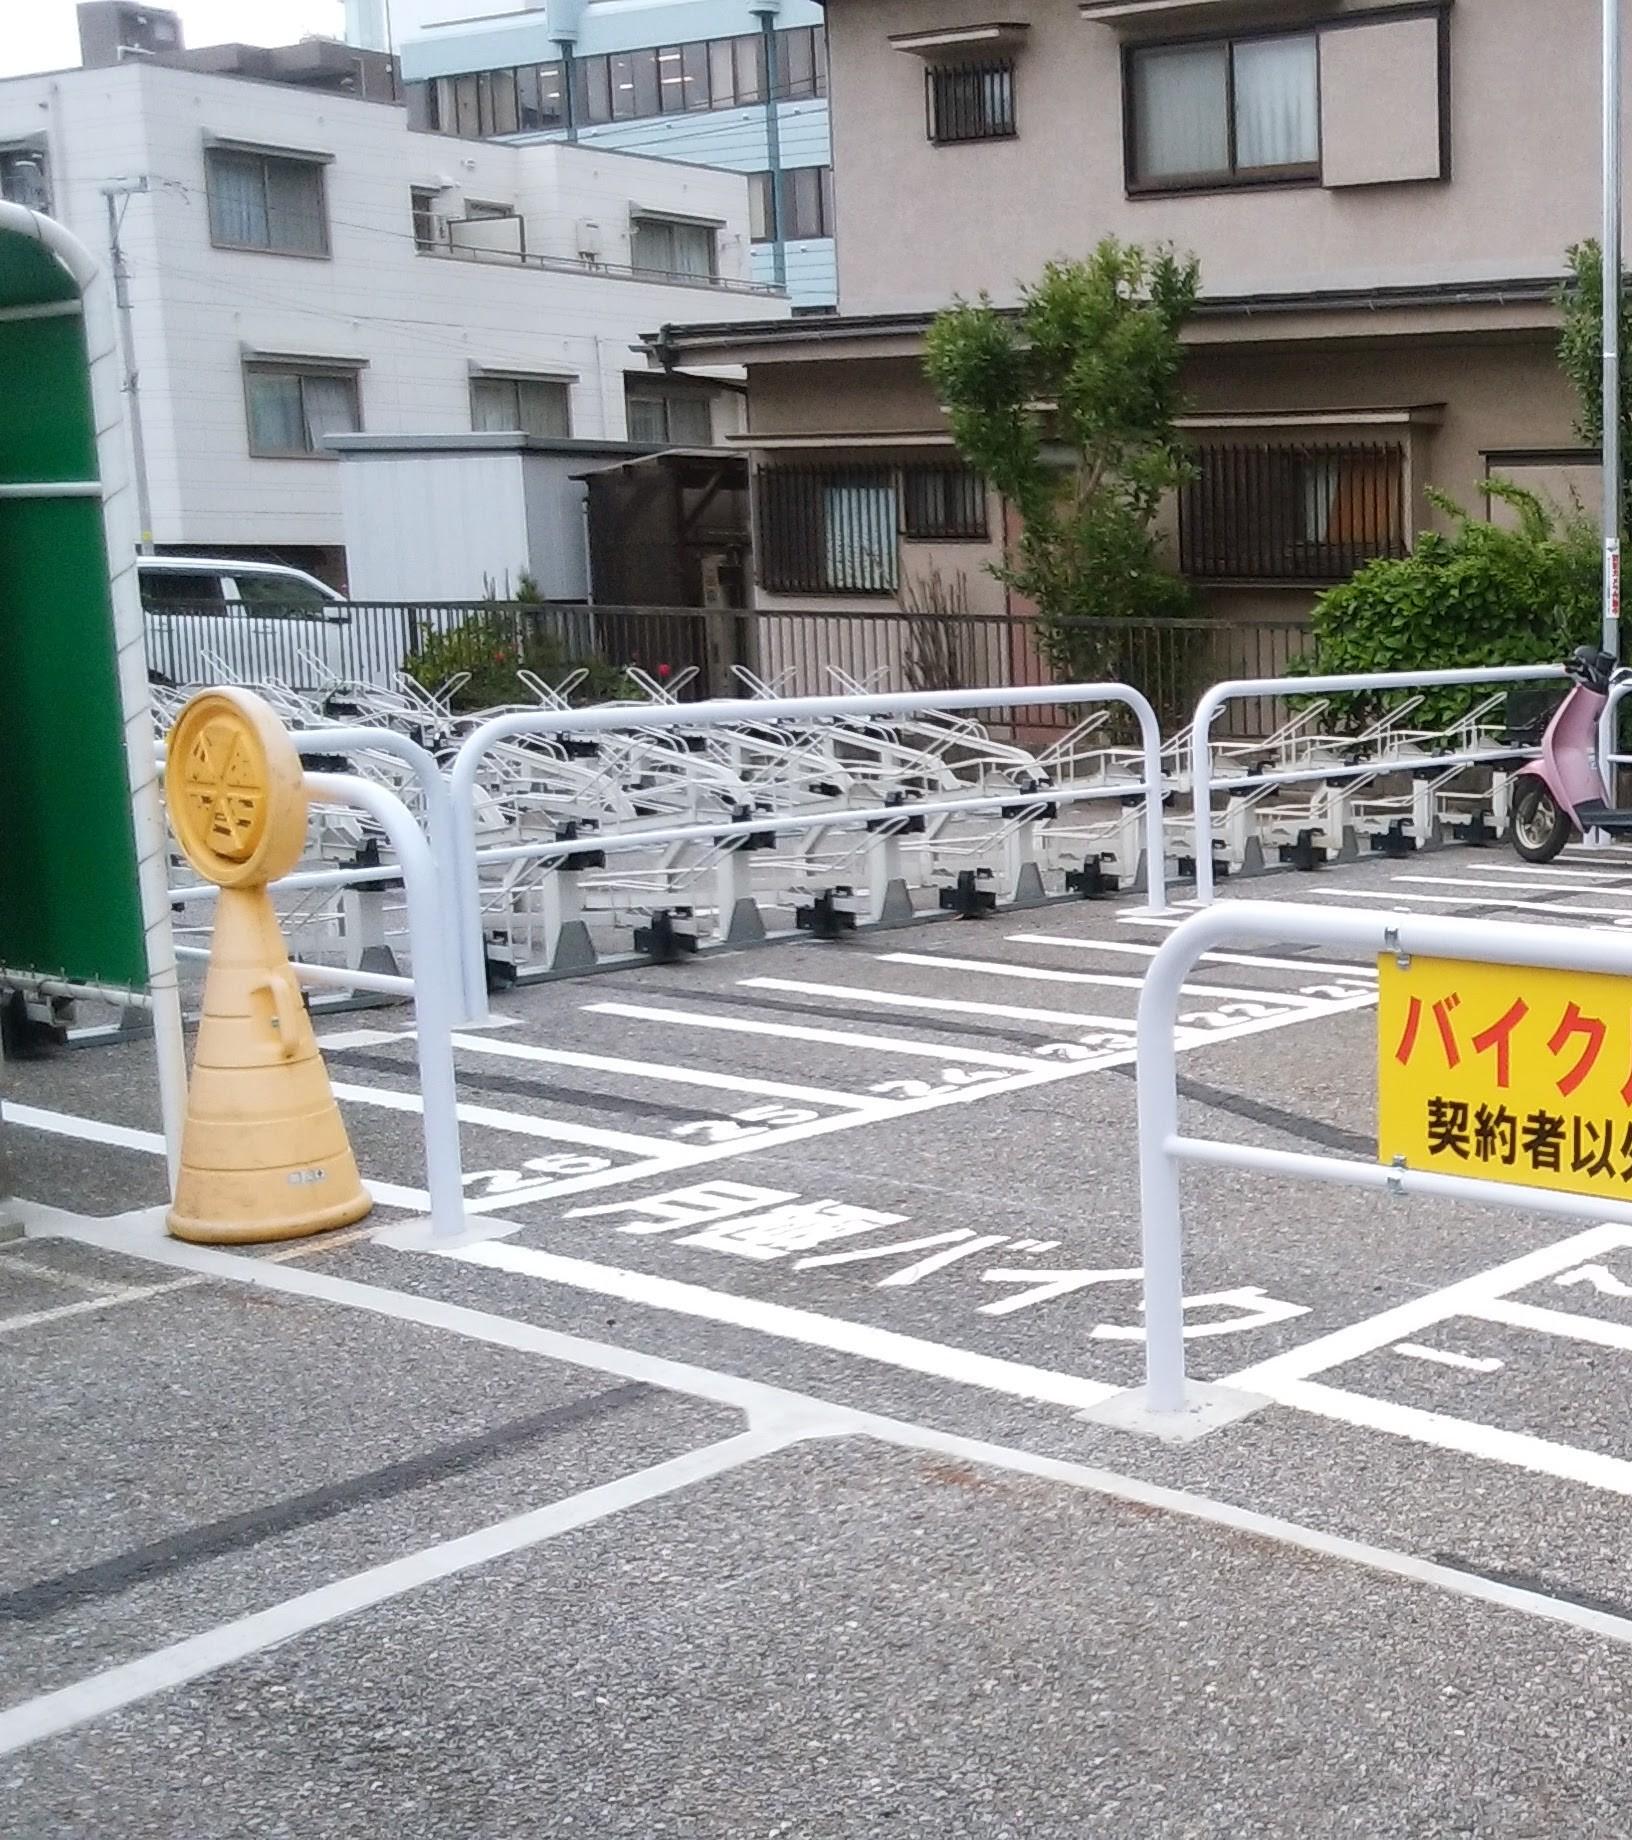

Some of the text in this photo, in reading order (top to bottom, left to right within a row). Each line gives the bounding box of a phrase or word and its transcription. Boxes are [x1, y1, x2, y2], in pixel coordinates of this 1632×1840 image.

[1178, 1003, 1292, 1027] 22
[673, 1105, 820, 1142] 25
[462, 1153, 614, 1193] 26
[1391, 1342, 1506, 1373] 1
